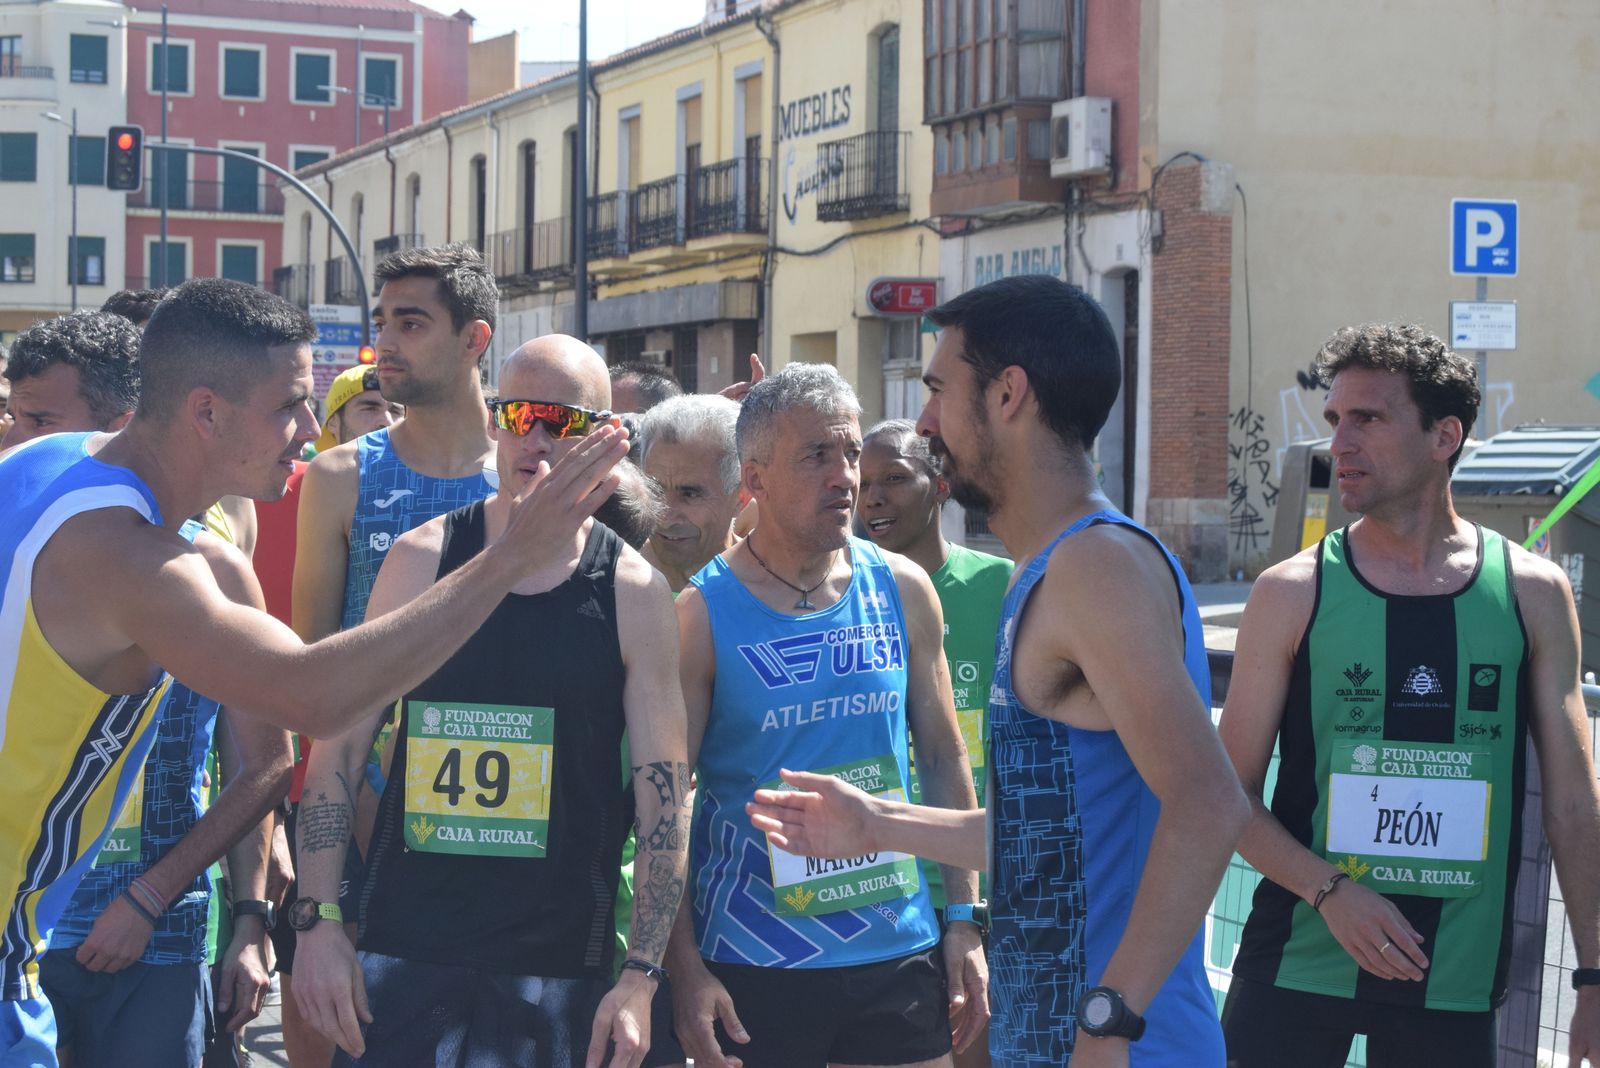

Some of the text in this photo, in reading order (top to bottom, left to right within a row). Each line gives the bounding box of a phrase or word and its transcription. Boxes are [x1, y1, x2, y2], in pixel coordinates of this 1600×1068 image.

[780, 84, 850, 142] MUEBLES
[1465, 208, 1505, 267] P
[975, 245, 1062, 288] BAR ANGLO
[827, 623, 900, 645] COMERCIAL
[831, 640, 903, 677] ULSA
[444, 709, 533, 727] FUNDACION
[761, 690, 901, 732] ATLETISMO
[444, 723, 532, 740] CAJA RURAL
[1381, 747, 1472, 765] FUNDACION
[1381, 761, 1472, 778] CAJA RURAL
[432, 748, 510, 808] 49
[1370, 784, 1379, 802] 4
[436, 826, 538, 845] CAJA RURAL
[1373, 802, 1443, 847] PEÓN
[817, 871, 910, 903] CAJA RURAL
[1372, 866, 1474, 885] CAJA RURAL
